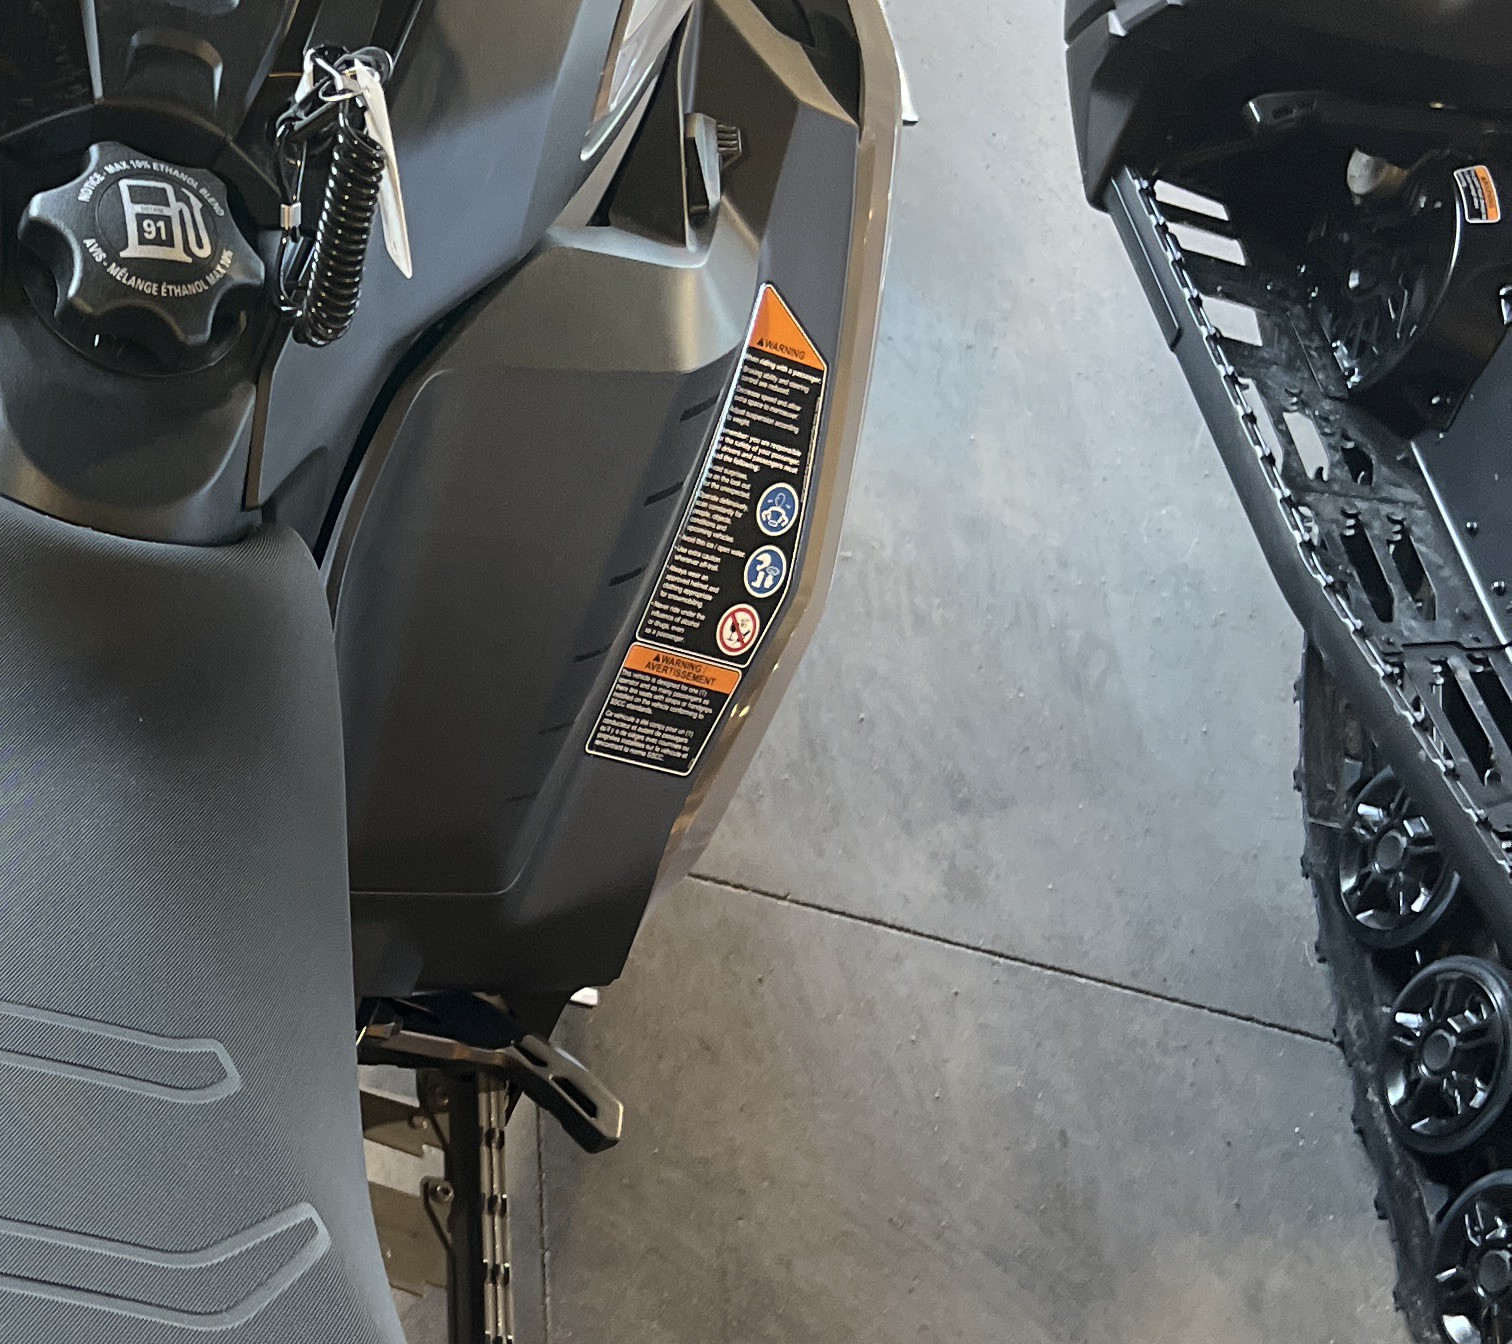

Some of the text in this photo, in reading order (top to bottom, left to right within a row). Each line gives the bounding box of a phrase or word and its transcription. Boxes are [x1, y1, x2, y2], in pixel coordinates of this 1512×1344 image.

[78, 171, 105, 203] NOTICE
[152, 161, 199, 190] ETHANOL
[199, 187, 225, 217] BLEND
[142, 218, 167, 241] 91
[83, 238, 107, 263] AVIS
[106, 262, 159, 296] MÉLANGE
[161, 281, 208, 298] ÉTHANOL
[765, 338, 806, 361] WARNING
[644, 661, 717, 686] AVERTISSEMENT
[661, 655, 702, 674] WARNING
